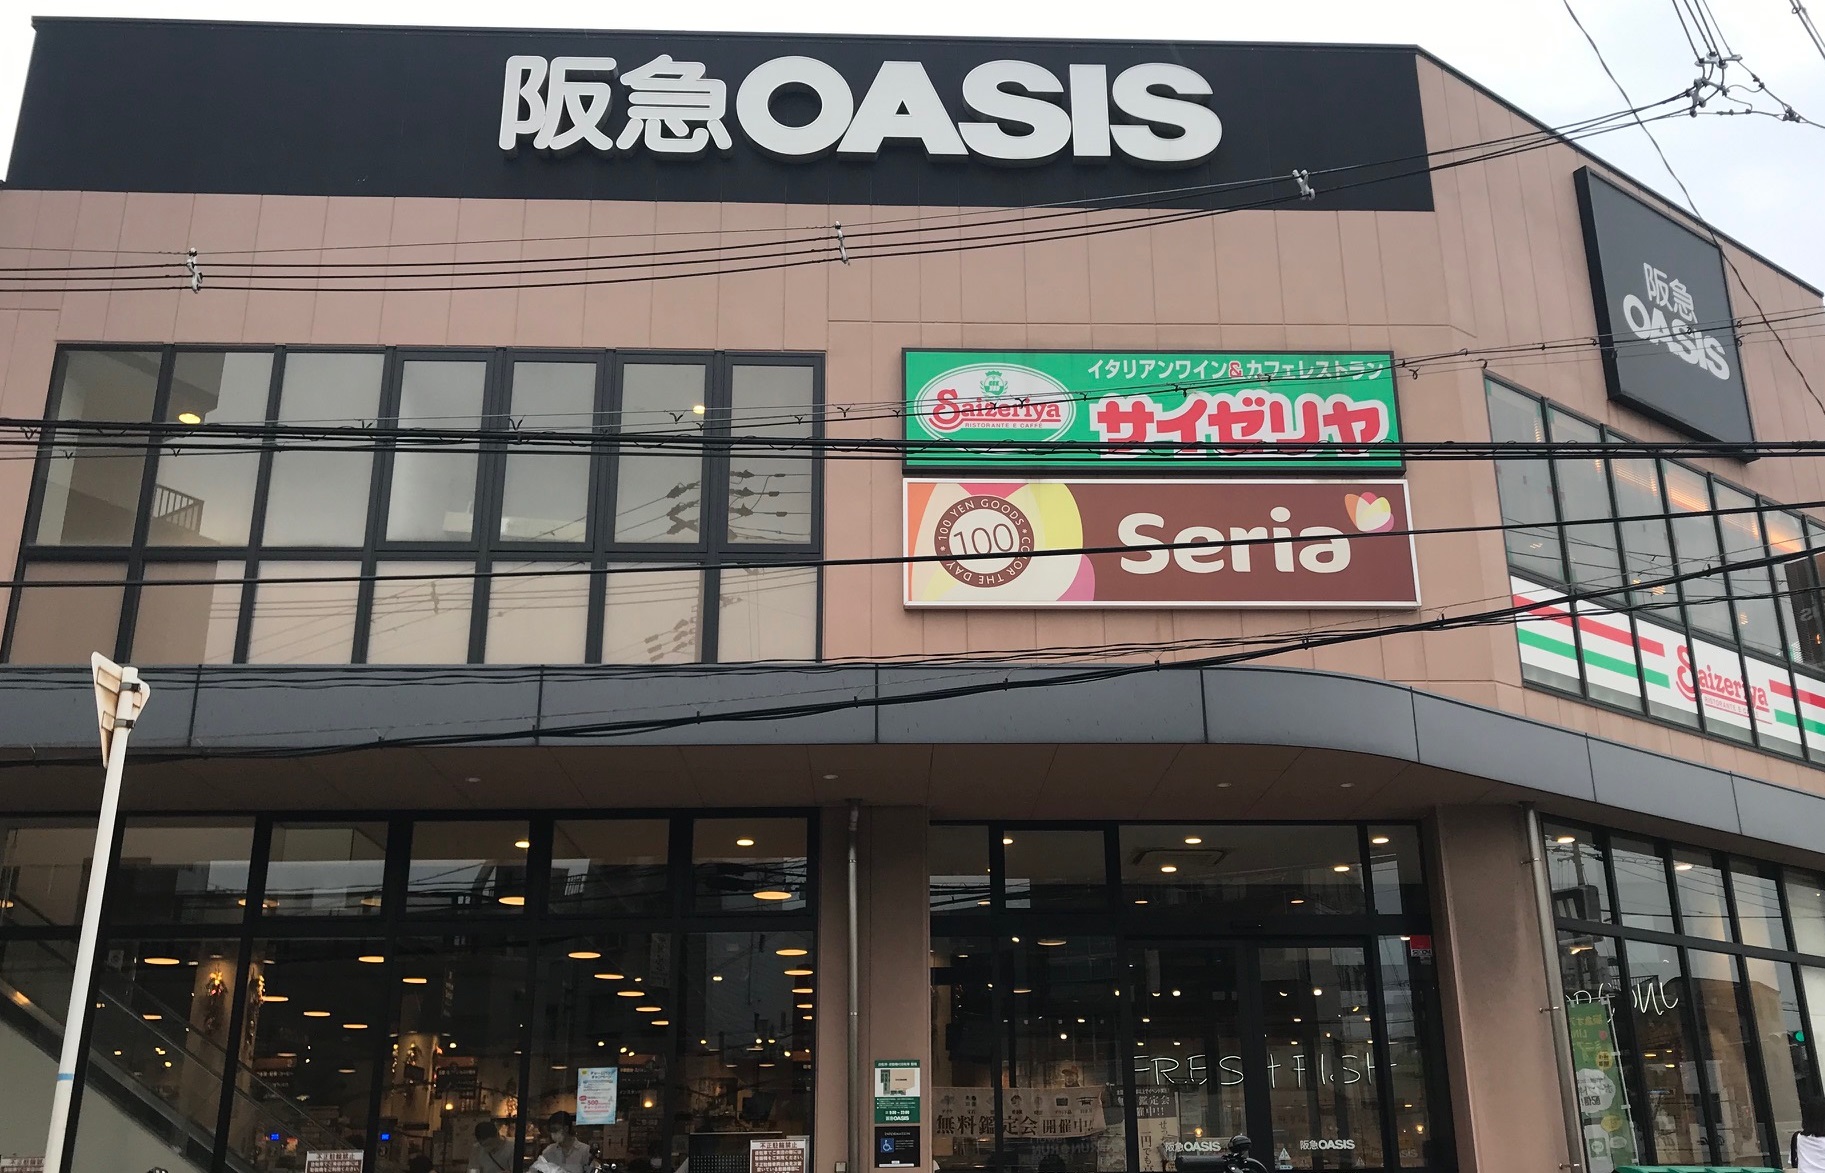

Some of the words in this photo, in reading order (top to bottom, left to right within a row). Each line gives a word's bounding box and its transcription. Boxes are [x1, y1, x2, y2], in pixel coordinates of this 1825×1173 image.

[1643, 262, 1698, 324] 阪急
[1623, 294, 1730, 380] OASIS
[930, 388, 1062, 428] Saizeriya
[1093, 394, 1384, 455] サイゼリヤ
[949, 500, 975, 518] YEN
[980, 498, 1025, 526] GOODS
[938, 519, 952, 541] 100
[953, 523, 1014, 555] 100
[1117, 506, 1352, 575] Seria
[945, 560, 973, 582] DAY
[1006, 536, 1031, 576] COOR
[978, 573, 1005, 585] THE
[1165, 1141, 1222, 1152] 阪急OASIS
[1300, 1139, 1356, 1150] 阪急OASIS
